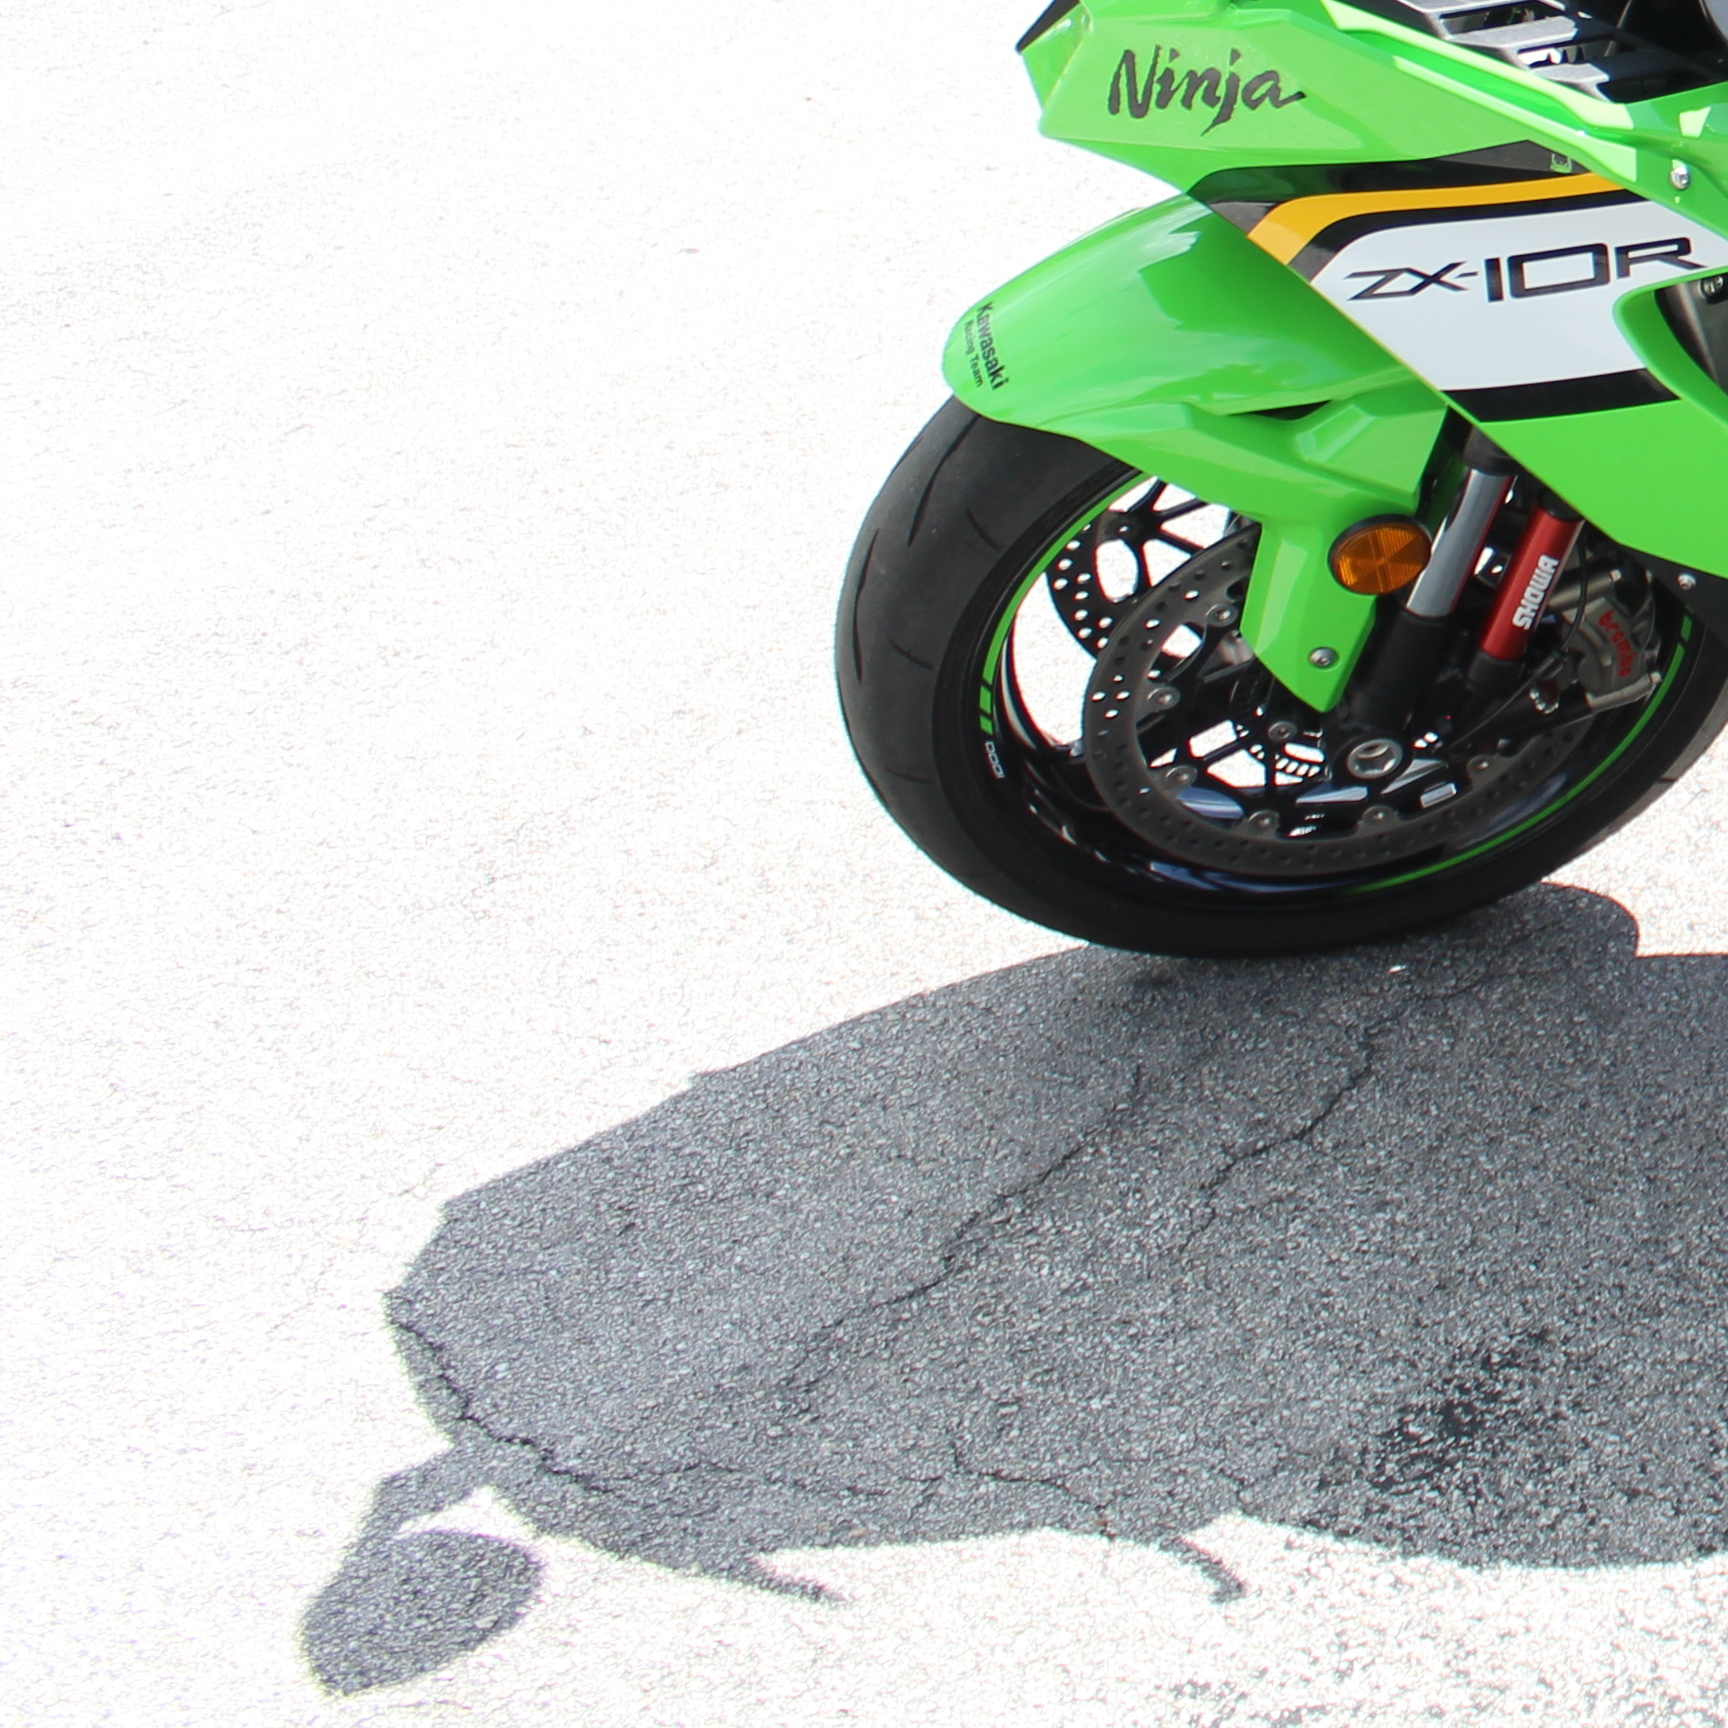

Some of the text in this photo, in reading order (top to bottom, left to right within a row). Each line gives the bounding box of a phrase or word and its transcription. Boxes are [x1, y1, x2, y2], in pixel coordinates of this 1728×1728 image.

[1108, 44, 1307, 136] Ninja
[1344, 237, 1708, 303] ZX-10R
[969, 353, 984, 389] Team
[976, 300, 1009, 391] Kawasaki
[1512, 554, 1559, 631] SHOWA
[1598, 609, 1636, 678] brembo
